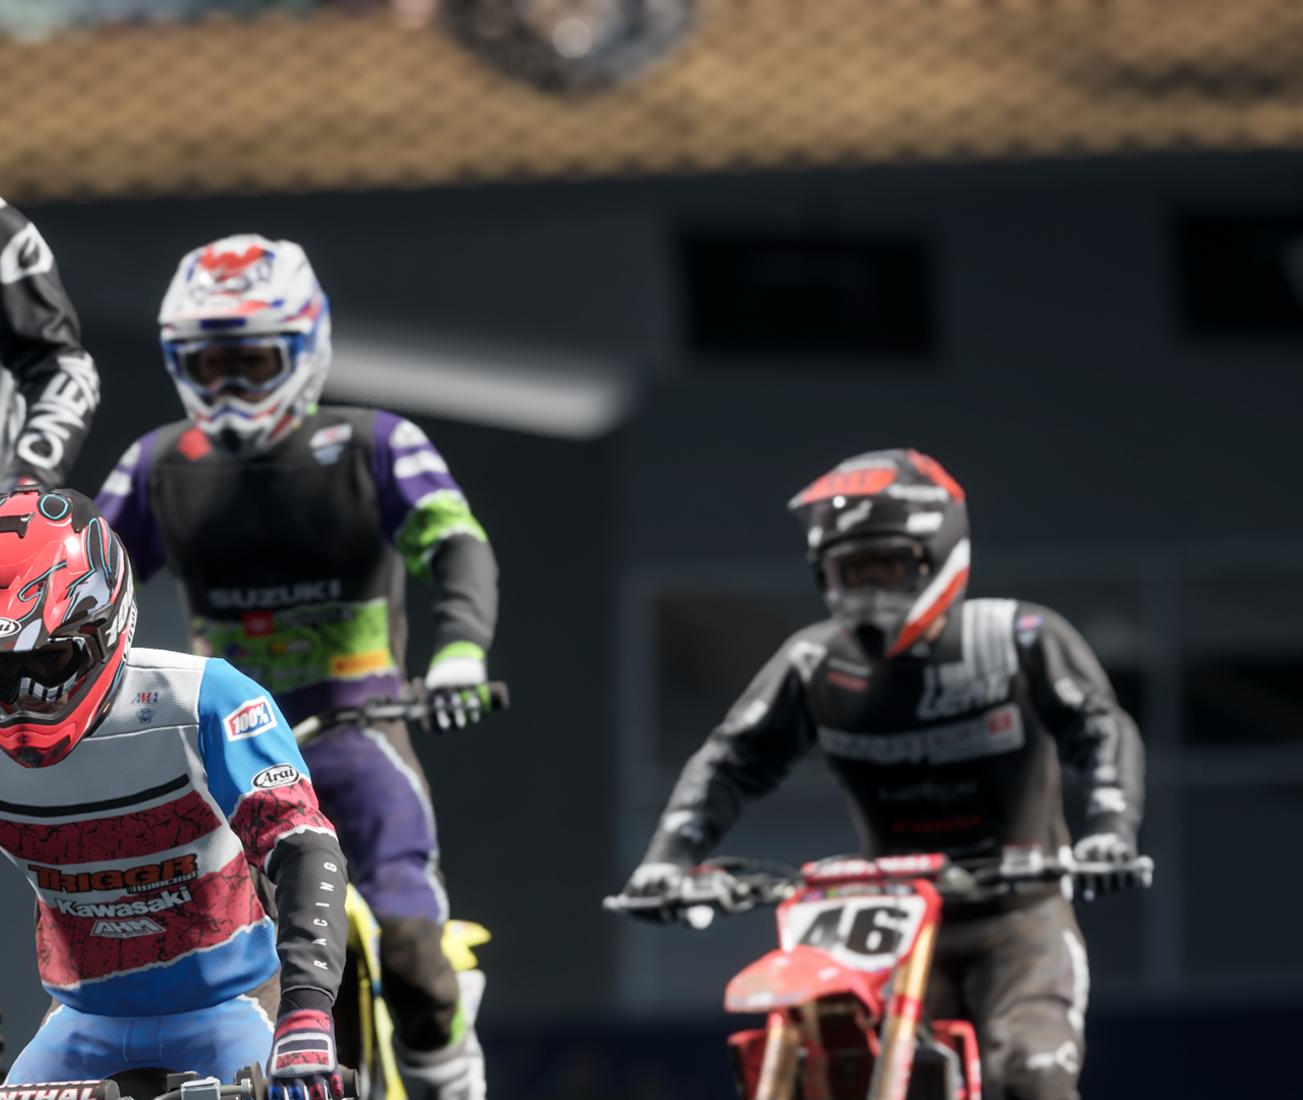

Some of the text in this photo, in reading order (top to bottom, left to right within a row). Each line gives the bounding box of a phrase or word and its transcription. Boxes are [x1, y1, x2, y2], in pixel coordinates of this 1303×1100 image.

[209, 579, 342, 609] SUZUKI
[232, 703, 270, 734] 100%
[258, 767, 295, 785] Arai
[28, 853, 198, 893] TRIGGR
[54, 886, 192, 919] Kawasaki
[312, 861, 338, 970] RACING
[798, 906, 910, 956] 46
